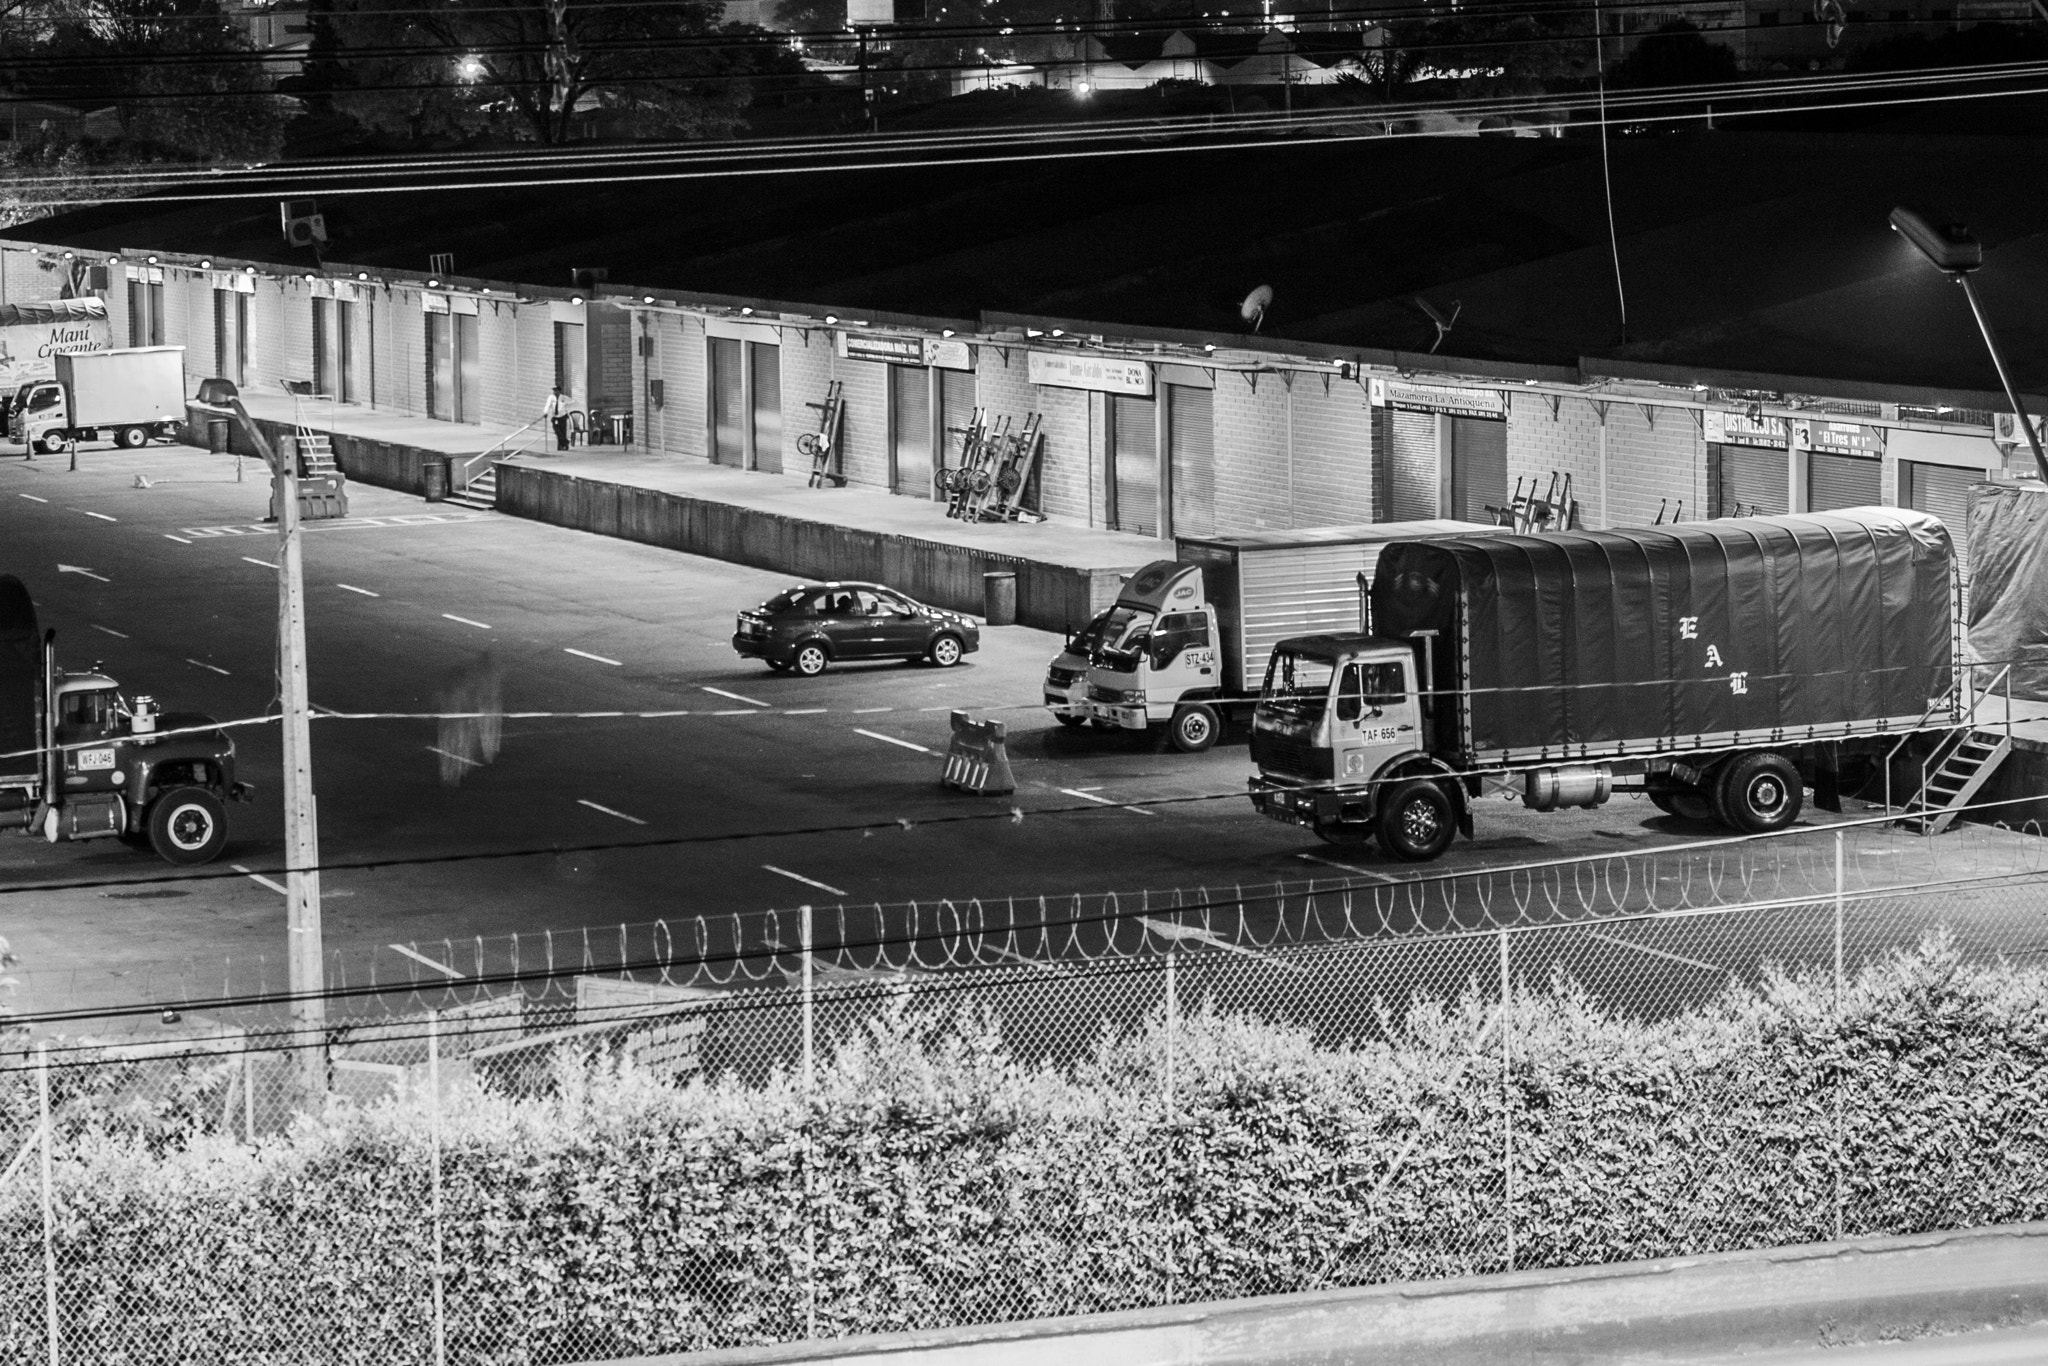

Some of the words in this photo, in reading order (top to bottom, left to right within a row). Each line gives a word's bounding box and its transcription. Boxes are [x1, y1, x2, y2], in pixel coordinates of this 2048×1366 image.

[50, 323, 90, 345] Maní
[38, 341, 102, 358] Crocante
[1390, 389, 1433, 402] Mazamorra
[1435, 394, 1446, 404] La
[1831, 431, 1848, 446] Tres
[1175, 589, 1193, 597] JAC
